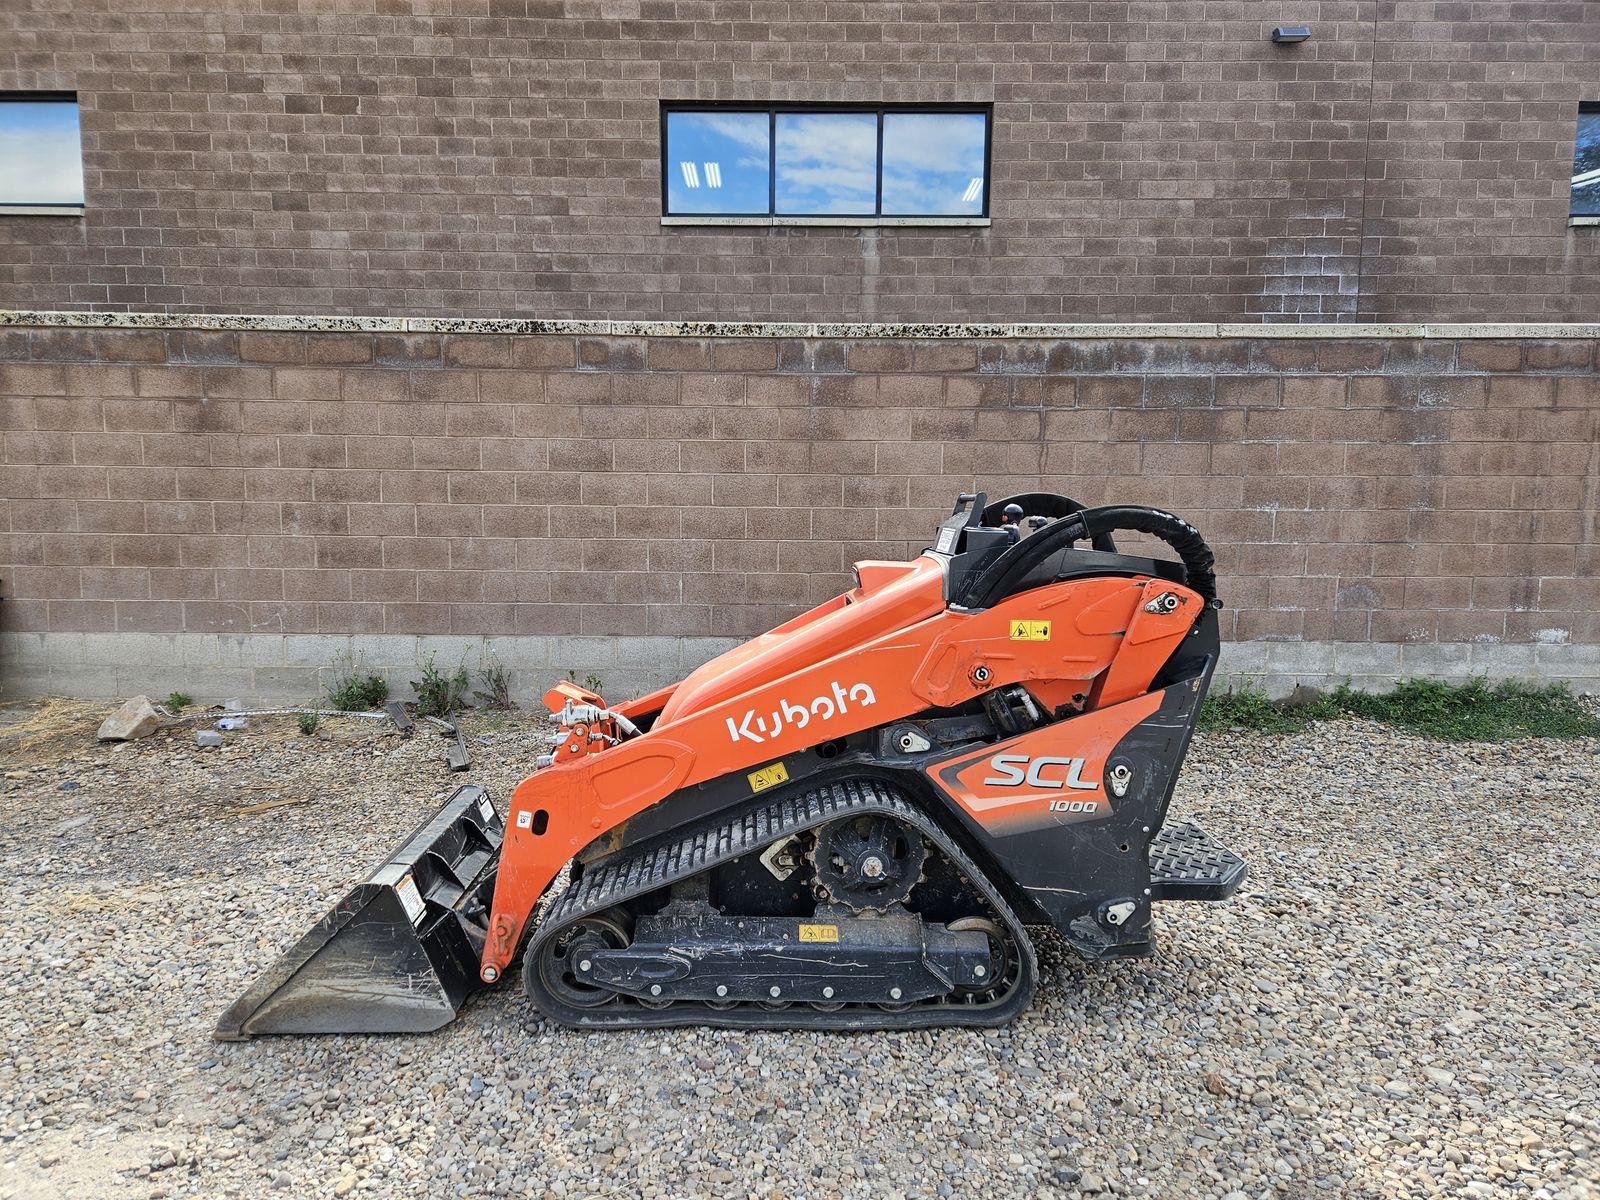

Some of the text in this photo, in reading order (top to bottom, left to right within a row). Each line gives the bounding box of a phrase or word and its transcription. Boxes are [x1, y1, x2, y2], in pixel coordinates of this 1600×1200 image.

[725, 681, 877, 743] Kubota
[984, 754, 1099, 790] SCL
[1049, 800, 1098, 813] 1000
